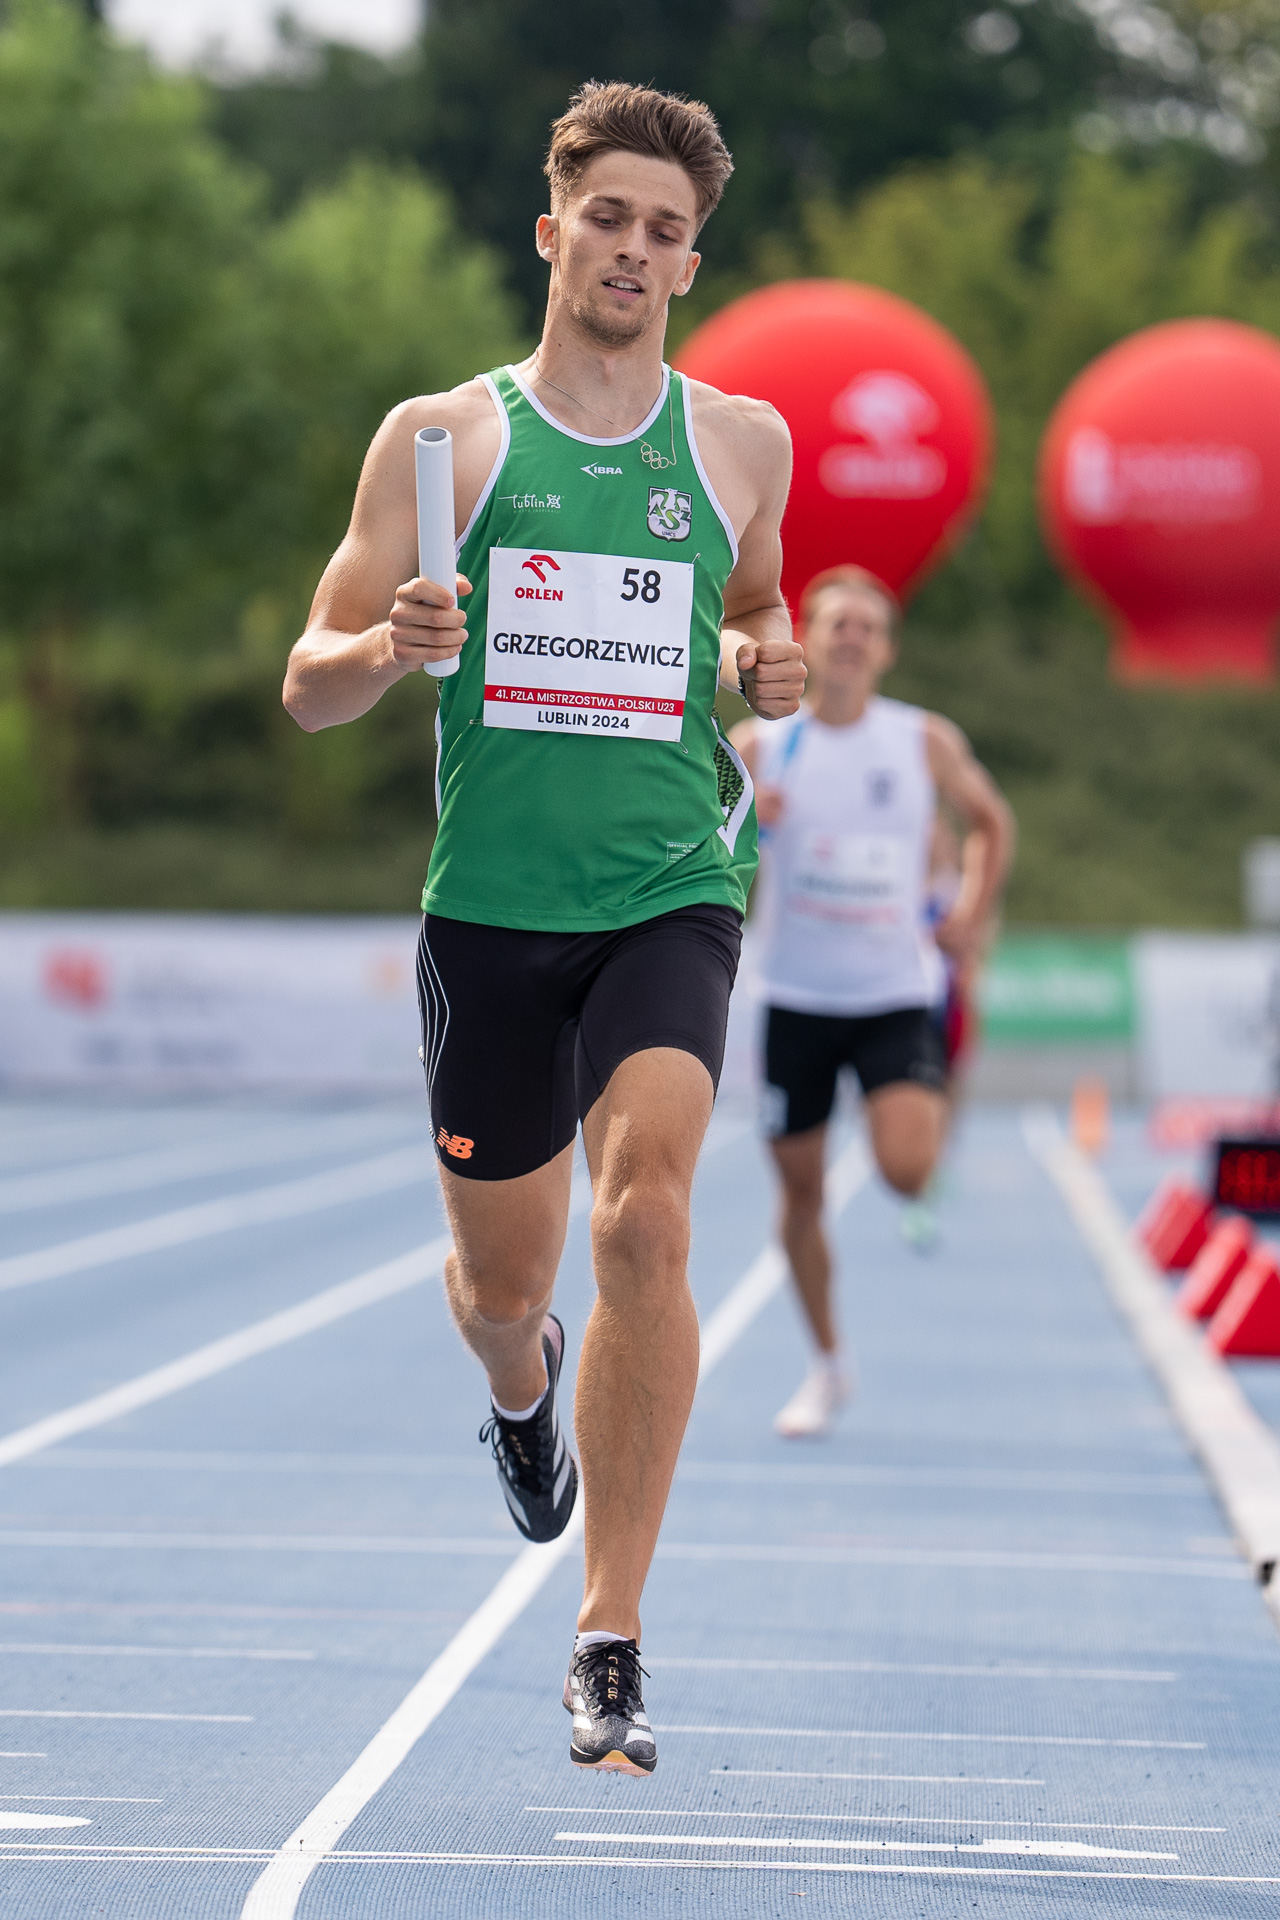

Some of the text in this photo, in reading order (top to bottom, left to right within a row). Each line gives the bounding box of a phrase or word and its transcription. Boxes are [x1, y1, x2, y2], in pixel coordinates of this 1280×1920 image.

[593, 466, 623, 475] IBRA
[514, 586, 564, 602] ORLEN
[620, 567, 662, 604] 58
[493, 632, 685, 668] GRZEGORZEWICZ
[495, 689, 675, 713] 41. PZLA MISTRZOSTWA POLSKI U23
[537, 710, 630, 730] LUBLIN 2024
